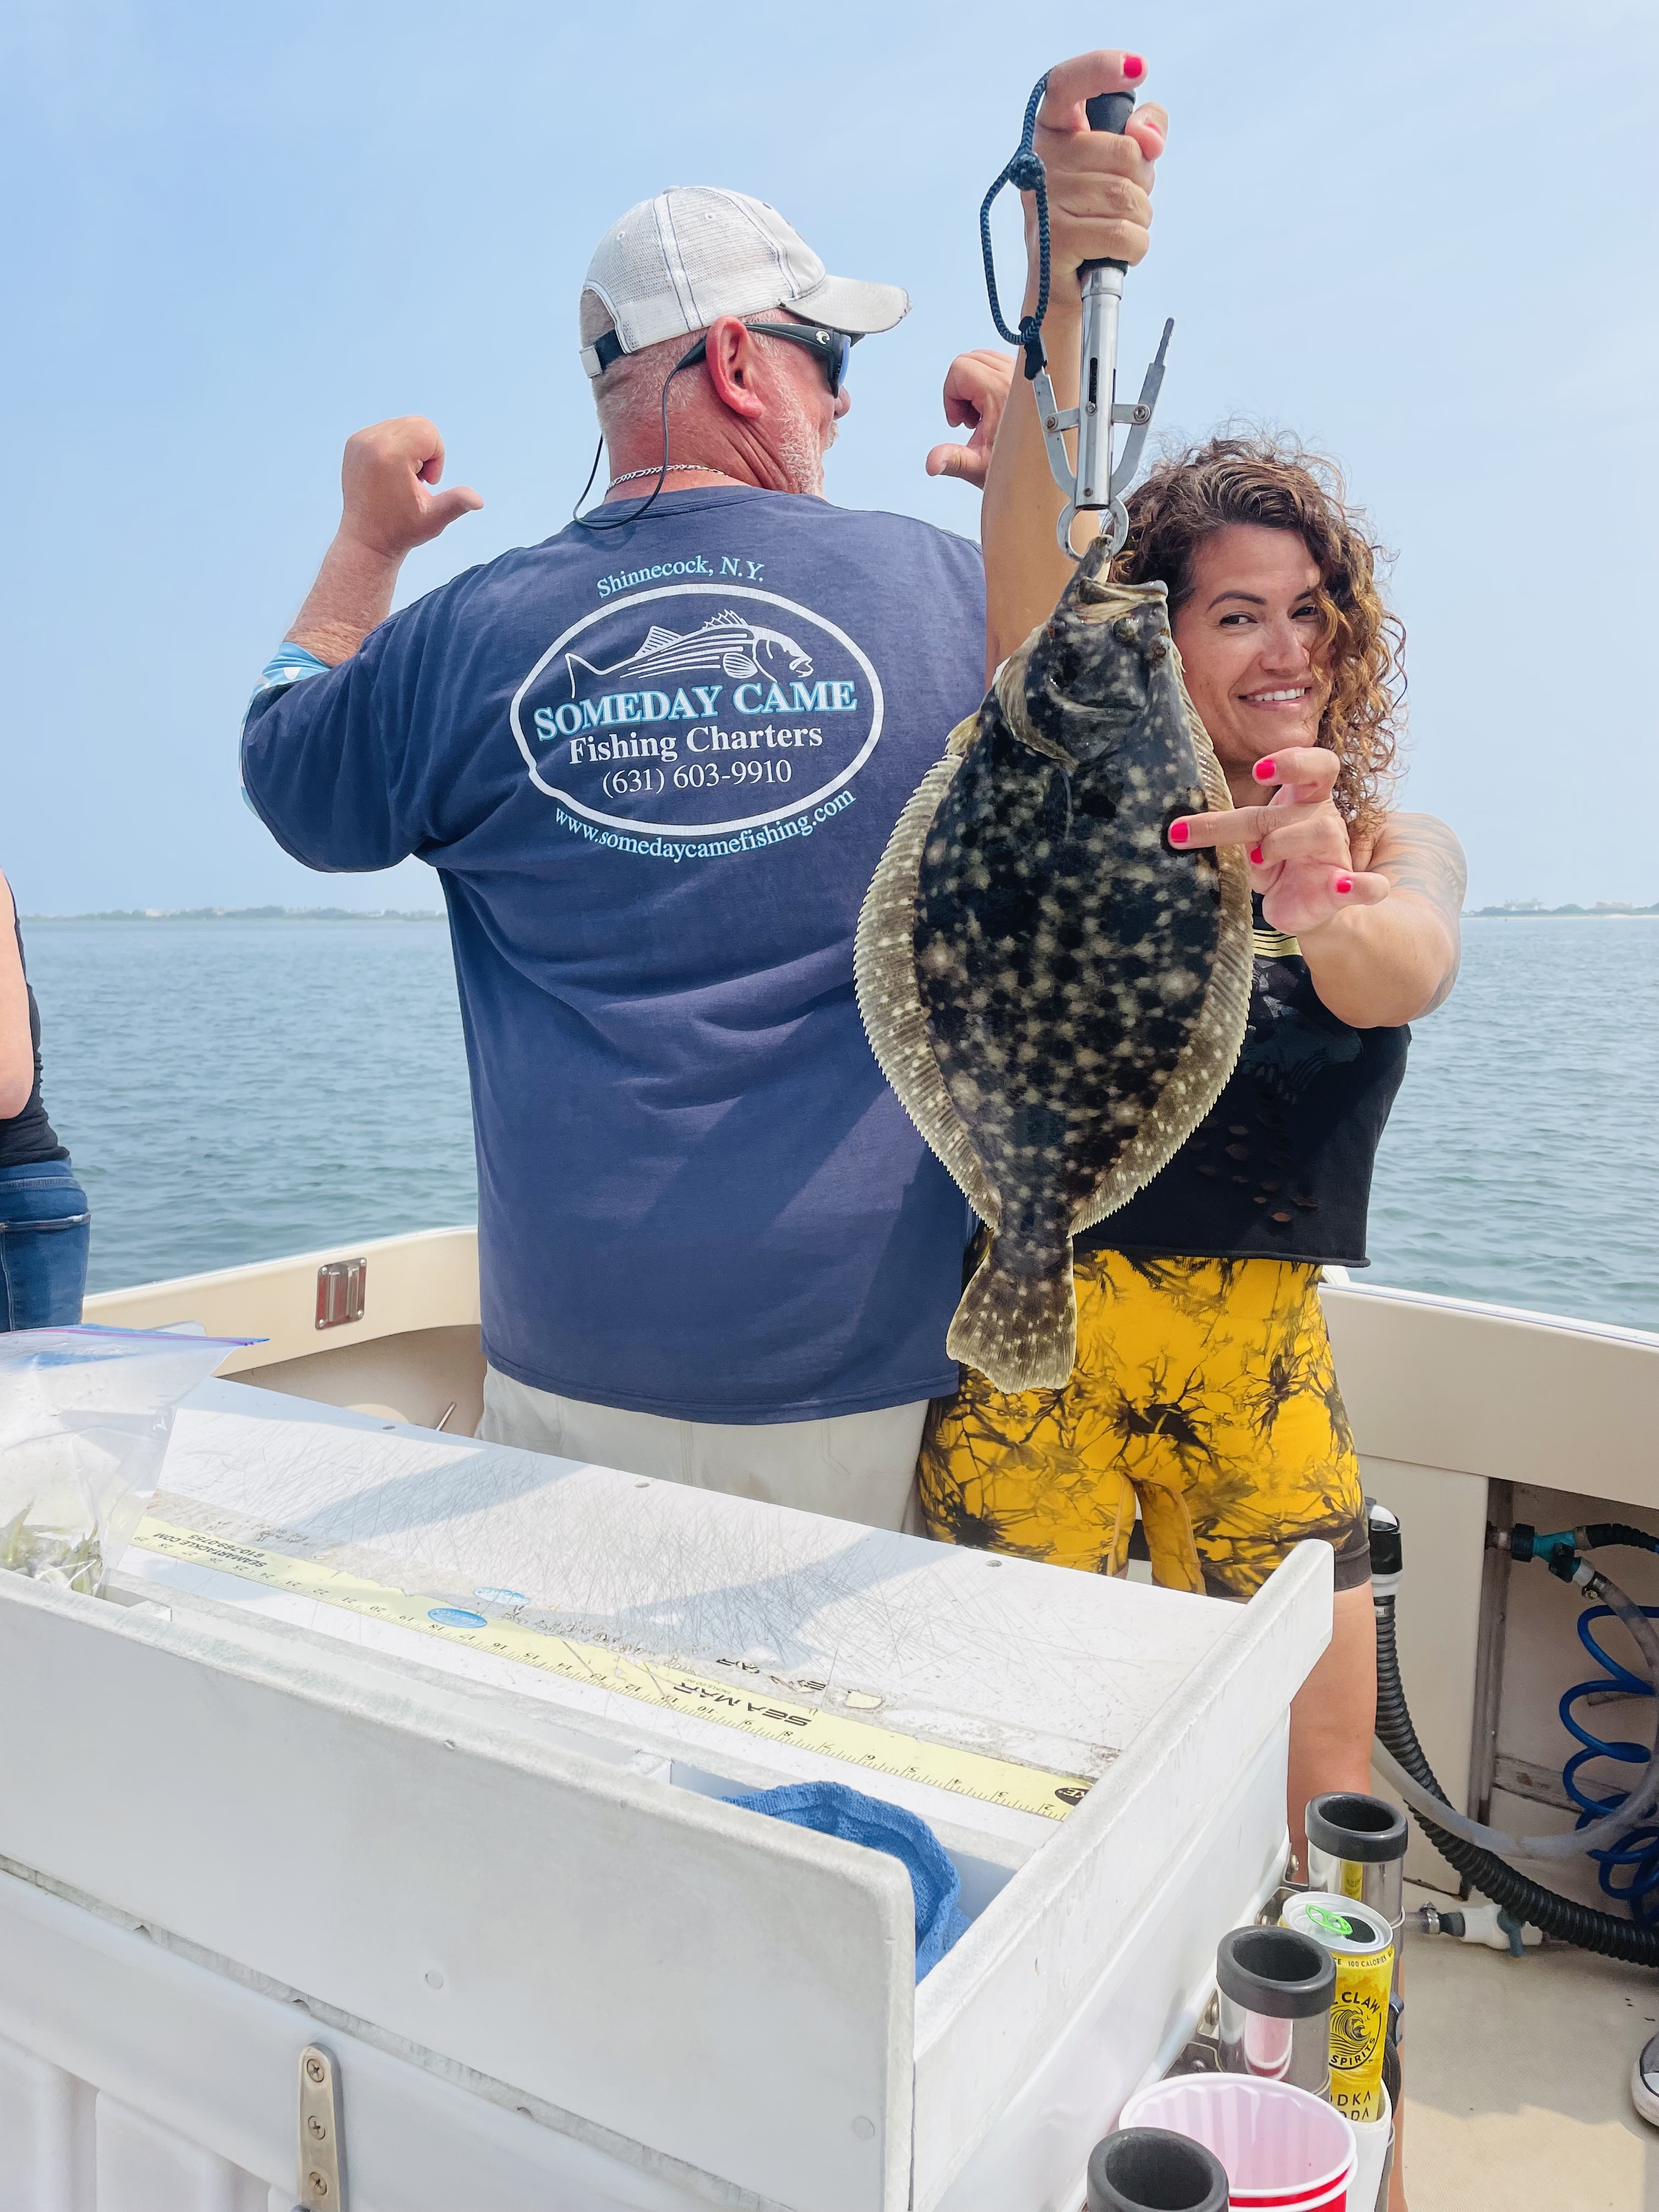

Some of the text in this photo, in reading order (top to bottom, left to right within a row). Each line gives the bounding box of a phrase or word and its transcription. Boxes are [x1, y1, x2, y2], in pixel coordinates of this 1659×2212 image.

[596, 555, 765, 599] Shinnecock, N.Y.
[533, 680, 858, 742] SOMEDAY CAME
[568, 723, 823, 764] Fishing Charters
[601, 758, 792, 799] (631) 603-9910
[555, 788, 856, 864] www.somedaycamefishing.com
[153, 1532, 267, 1567] SEAMARTACKLE.COM
[187, 1534, 266, 1558] 610-769-0755
[674, 1682, 812, 1726] SEA MAR
[1361, 1955, 1386, 1967] CALORIES
[1341, 1991, 1380, 2014] CLAW
[1330, 2038, 1375, 2066] SPIRITS
[1330, 2090, 1371, 2106] DKA
